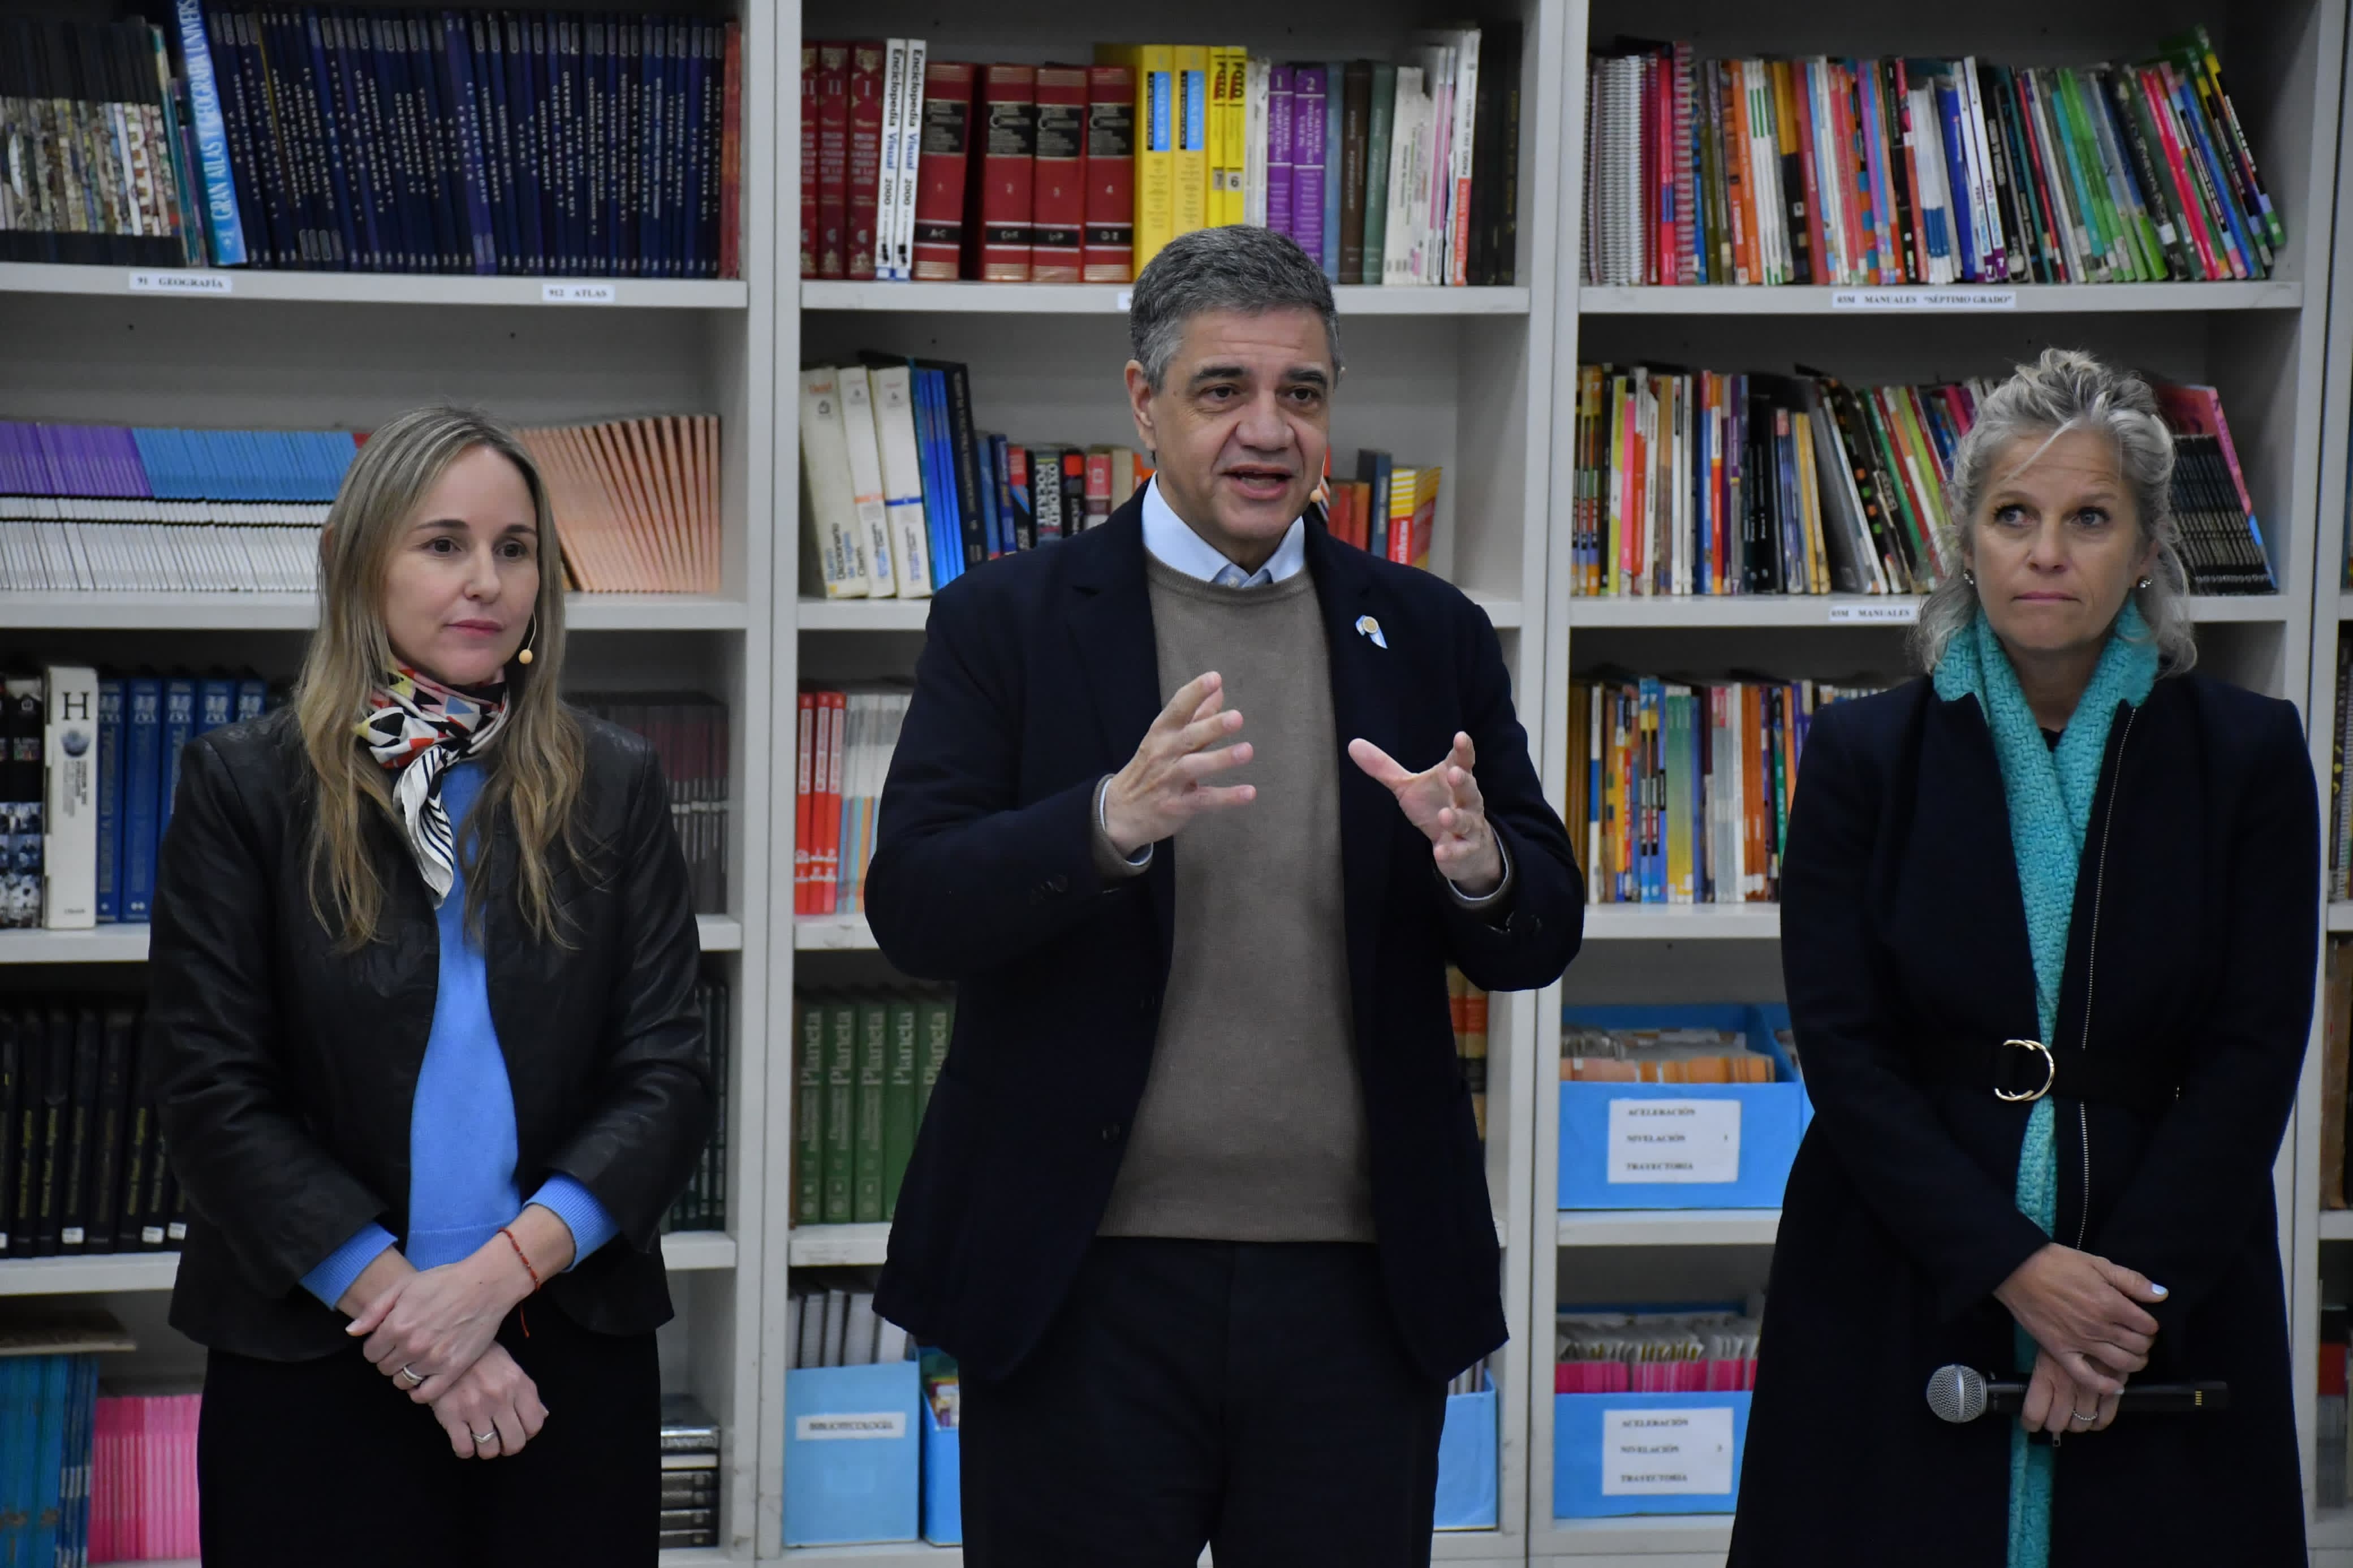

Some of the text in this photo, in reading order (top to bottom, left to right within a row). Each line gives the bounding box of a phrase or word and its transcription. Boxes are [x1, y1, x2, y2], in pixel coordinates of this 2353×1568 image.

[1232, 62, 1244, 98] FOTO
[1275, 75, 1282, 88] 1
[1307, 76, 1315, 92] 2
[1156, 76, 1167, 145] ARGENTINA
[883, 48, 905, 205] Enciclopedia Visual 2000
[903, 49, 925, 205] Enciclopedia Visual 2000
[200, 140, 227, 179] ATLAS
[1230, 175, 1239, 188] 6
[207, 180, 232, 221] GRAN
[137, 276, 223, 288] 91 GEOGRAFÍA
[549, 289, 564, 297] 912
[1864, 295, 1917, 304] MANUALES
[1036, 464, 1048, 526] POCKET
[1048, 463, 1060, 526] OXFORD
[829, 522, 847, 580] Diccionario
[1859, 609, 1910, 617] MANUALES
[62, 691, 89, 720] H
[800, 1011, 821, 1086] Planeta
[829, 1011, 851, 1086] Planeta
[860, 1011, 884, 1086] Planeta
[891, 1011, 914, 1086] Planeta
[1628, 1105, 1695, 1116] ACELERACIÓN
[1627, 1133, 1686, 1142] NIVELACIÓN
[1627, 1162, 1693, 1170] TRAYECTORIA
[1622, 1417, 1689, 1427] ACELERACIÓN
[1621, 1444, 1679, 1454] NIVELACIÓN
[1621, 1474, 1688, 1483] TRAYECTORIA
